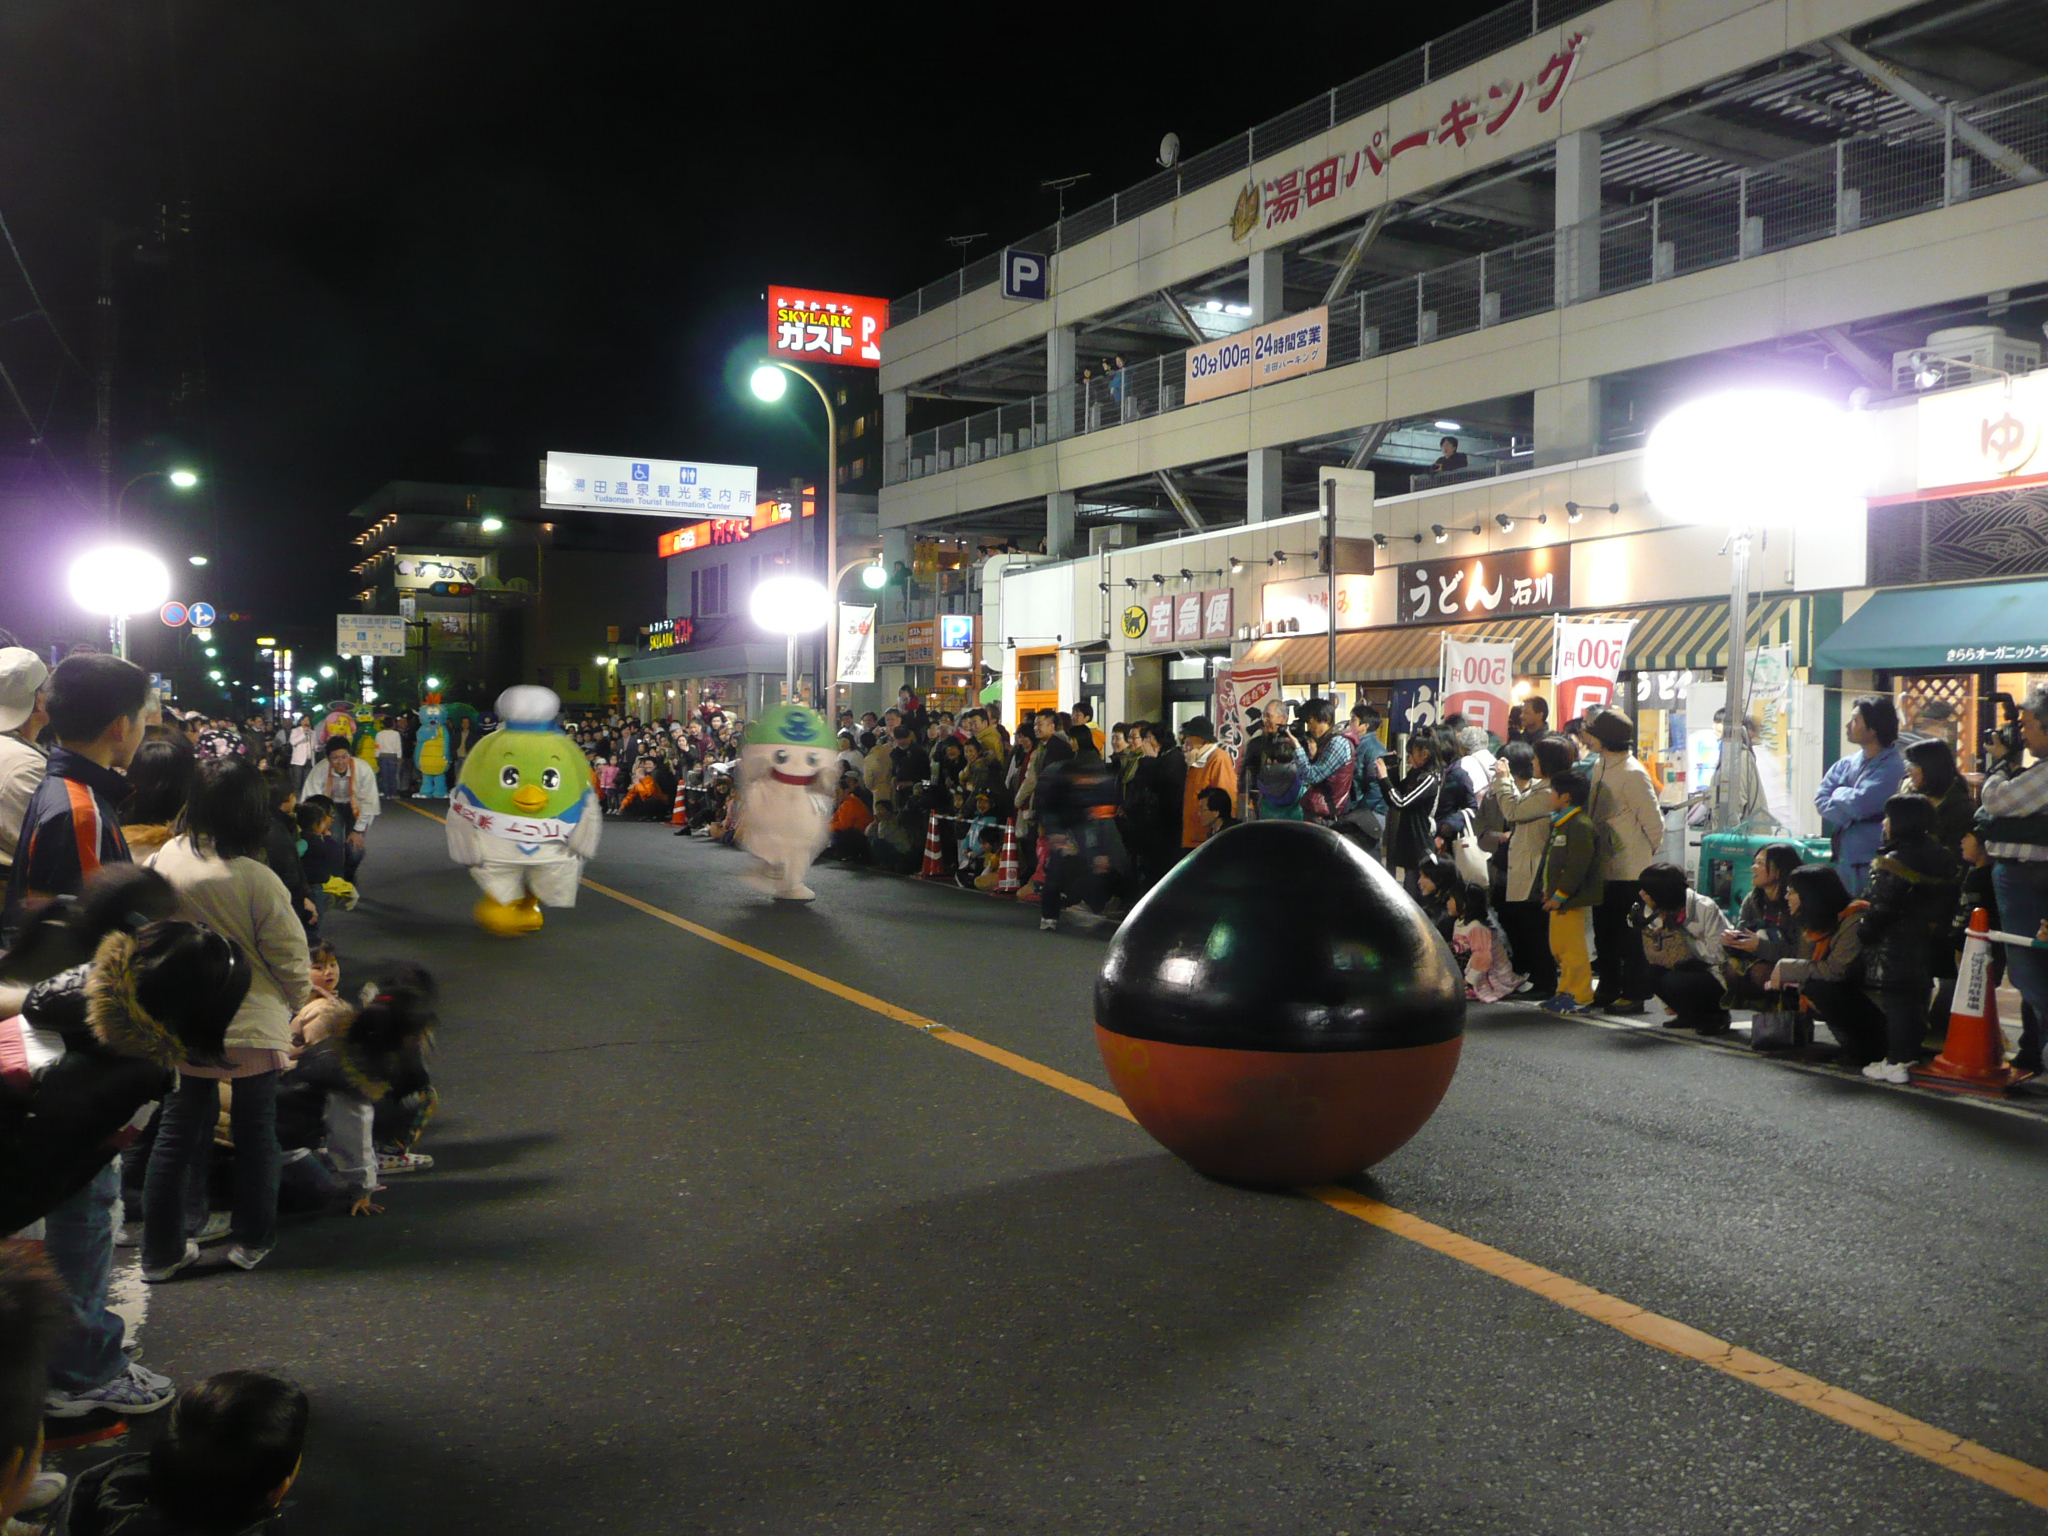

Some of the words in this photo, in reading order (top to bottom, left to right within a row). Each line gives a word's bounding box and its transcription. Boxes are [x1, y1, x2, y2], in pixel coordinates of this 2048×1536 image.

[1264, 31, 1584, 229] 湯田パーキング
[1013, 257, 1039, 292] P
[777, 298, 853, 315] レストラン
[777, 309, 852, 329] SKYLARK
[777, 321, 853, 355] ガスト
[862, 316, 876, 342] P
[1192, 343, 1250, 379] 30分100円
[1255, 325, 1322, 361] 24時間営業
[1263, 347, 1319, 375] 湯田パーキング
[1981, 412, 2025, 462] ゆ
[573, 478, 752, 504] 湯田温泉観光案内所
[638, 497, 663, 506] Tourist
[665, 499, 707, 508] Information
[707, 502, 731, 511] Center
[1410, 561, 1503, 617] うどん
[1510, 573, 1553, 606] 石川
[1151, 593, 1231, 637] 宅急便
[946, 619, 968, 647] P
